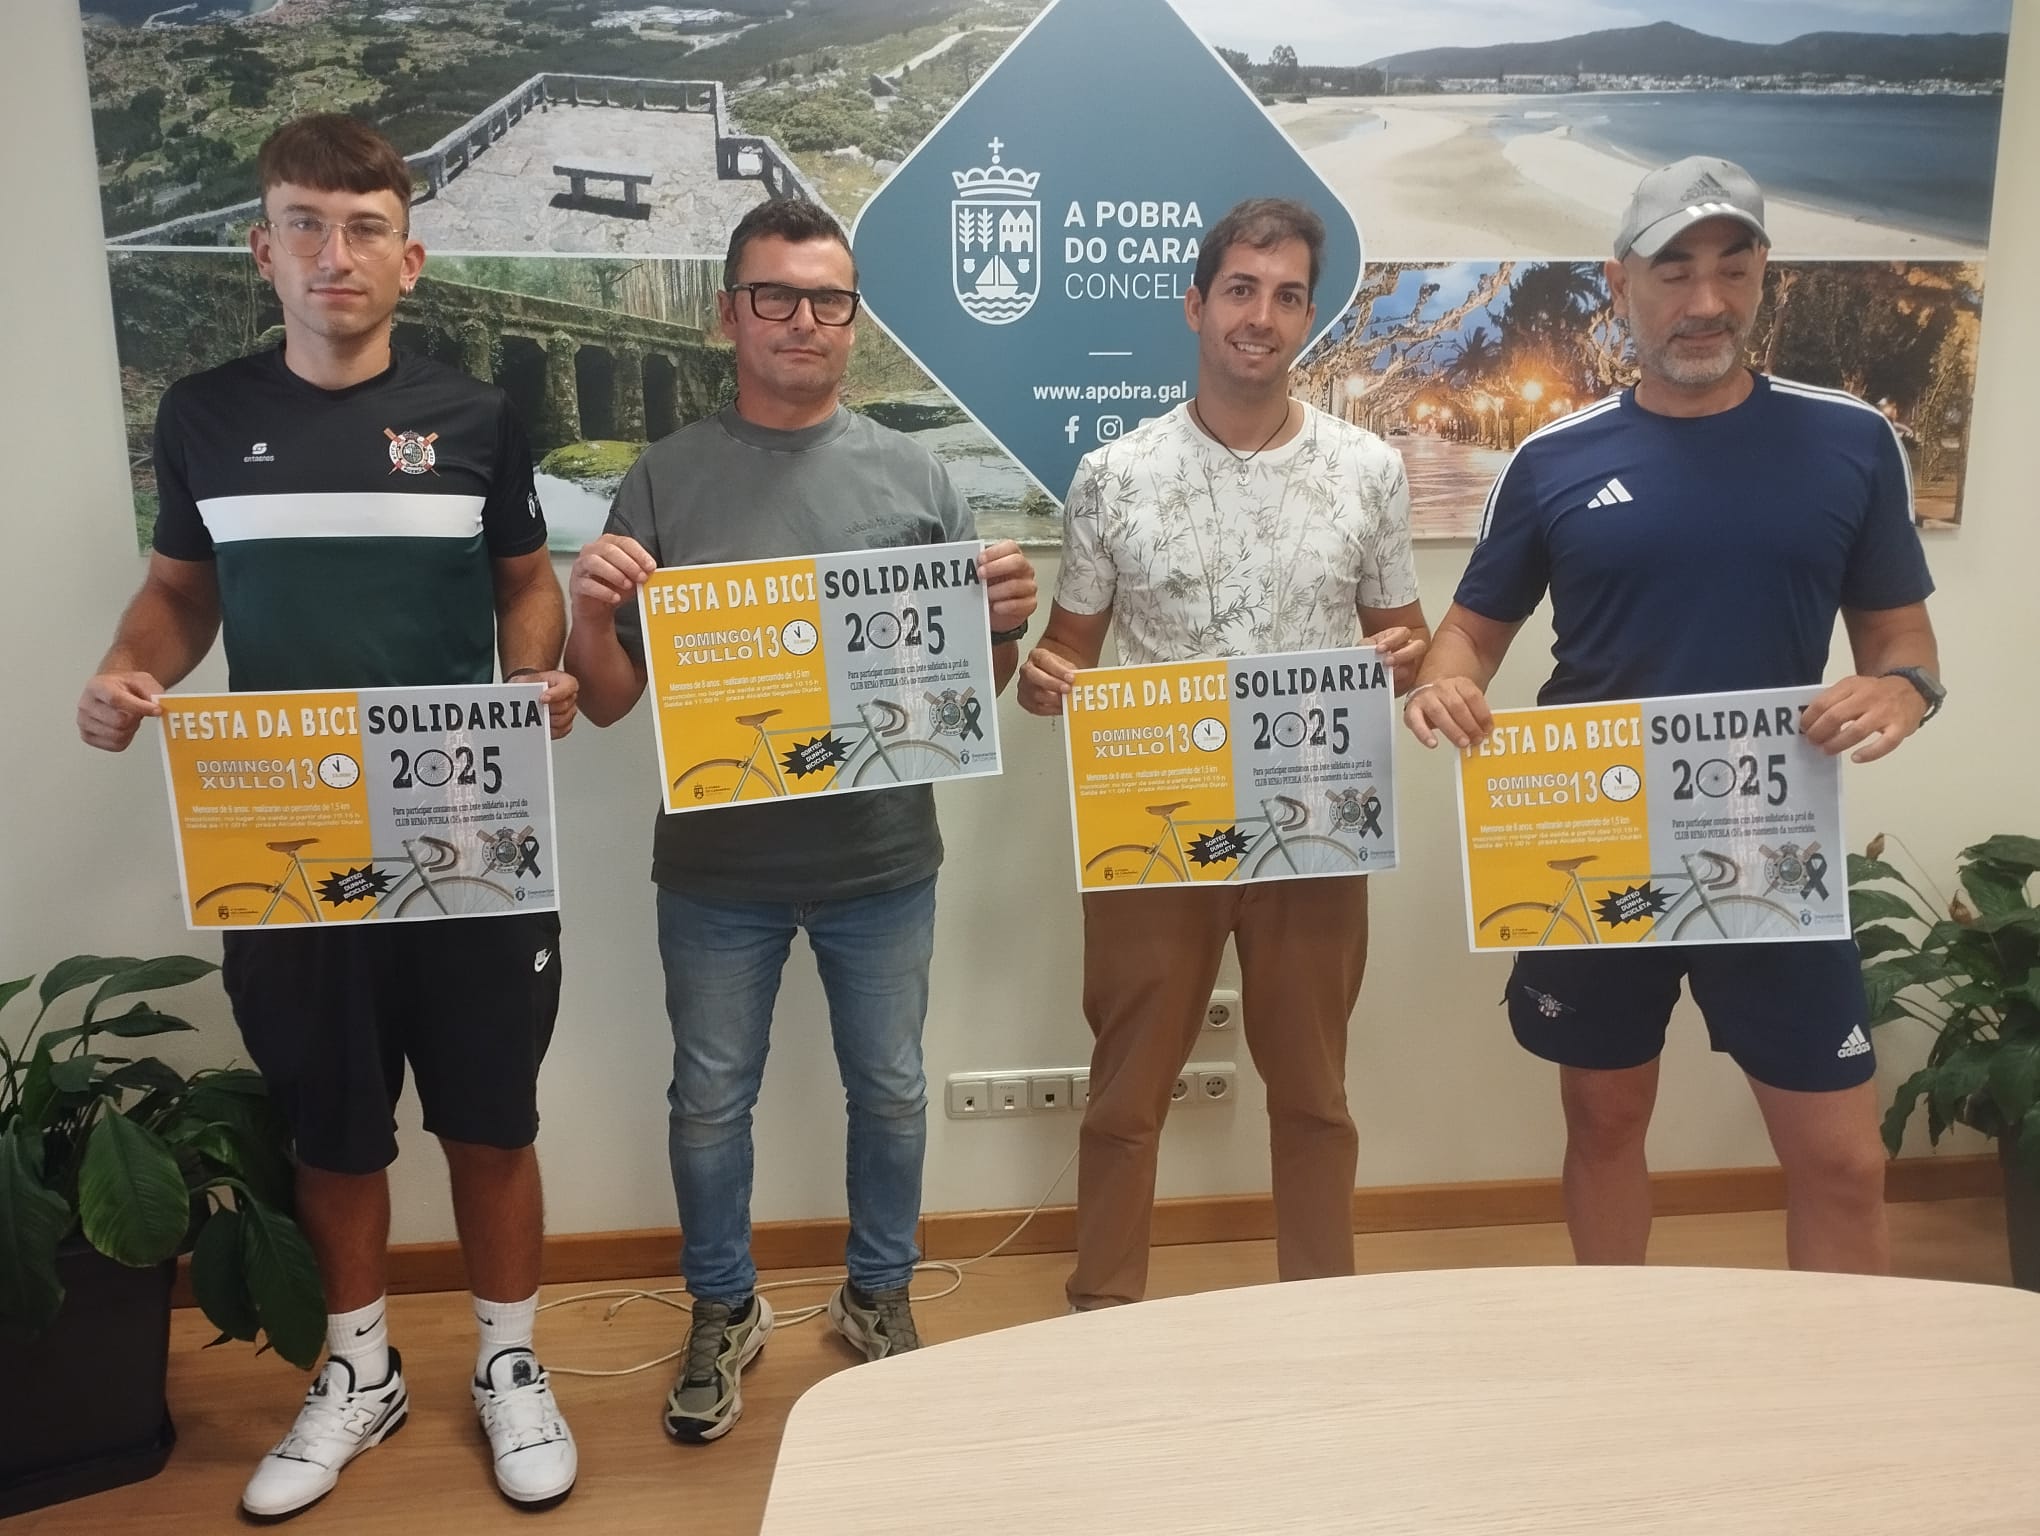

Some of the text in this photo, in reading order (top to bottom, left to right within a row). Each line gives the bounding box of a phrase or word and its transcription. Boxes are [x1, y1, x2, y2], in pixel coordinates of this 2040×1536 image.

[1063, 200, 1203, 228] A POBRA
[1065, 236, 1107, 264] DO
[1033, 381, 1187, 403] www.apobra.gal
[648, 557, 979, 615] FESTA DA BICI SOLIDARIA
[673, 628, 750, 649] DOMINGO
[751, 625, 780, 659] 13
[676, 645, 753, 665] XULLO
[1071, 661, 1386, 711] FESTA DA BICI SOLIDARIA
[168, 700, 543, 740] FESTA DA BICI SOLIDARIA
[1091, 725, 1163, 743] DOMINGO
[1164, 722, 1190, 754] 13
[1466, 726, 1536, 758] ESTA
[1544, 722, 1577, 751] DA
[1585, 717, 1640, 749] BICI
[1094, 741, 1164, 758] XULLO
[195, 758, 283, 774] DOMINGO
[284, 756, 316, 789] 13
[200, 775, 285, 791] XULLO
[1486, 772, 1567, 791] DOMINGO
[1569, 770, 1598, 804] 13
[1489, 789, 1568, 807] XULLO
[1838, 1042, 1870, 1058] adidas
